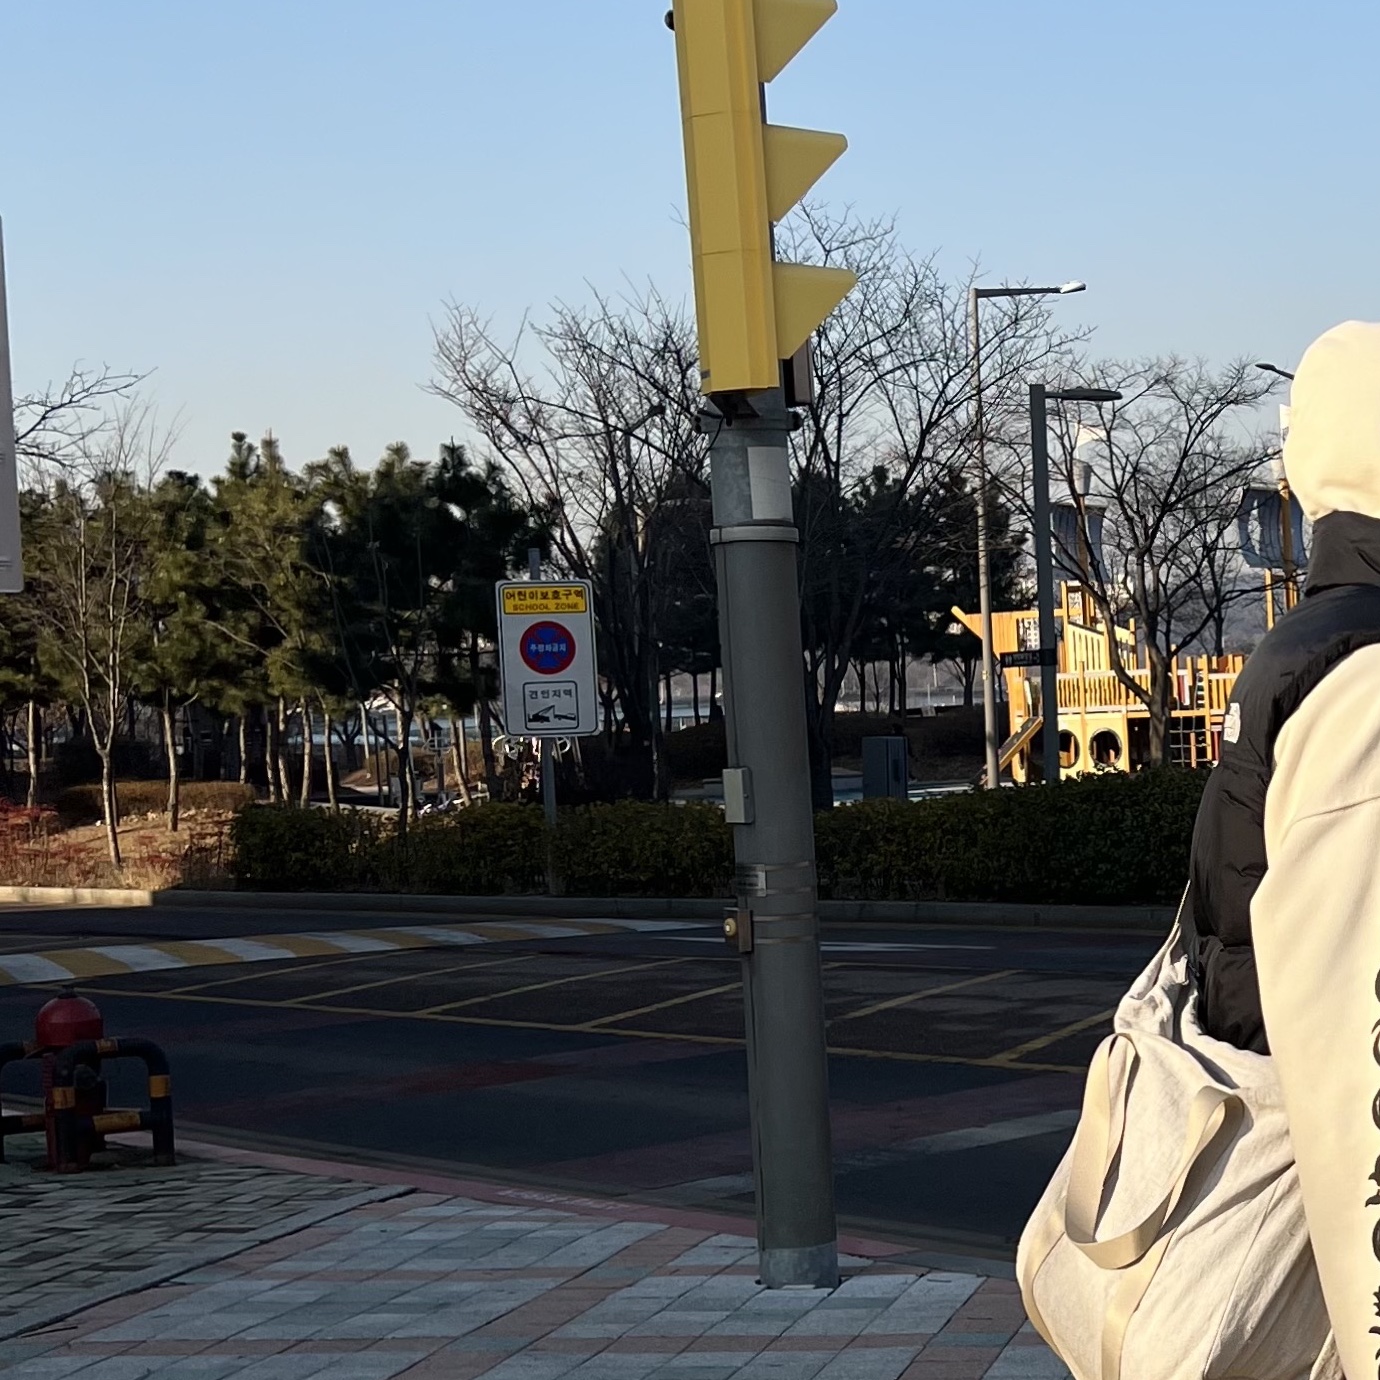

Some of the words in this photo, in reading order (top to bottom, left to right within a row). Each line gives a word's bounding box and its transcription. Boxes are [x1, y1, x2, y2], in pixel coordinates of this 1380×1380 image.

[505, 589, 584, 601] 어린이보호구역
[512, 602, 551, 611] SCHOOL
[554, 602, 580, 610] ZONE
[528, 688, 573, 700] 견인지역
